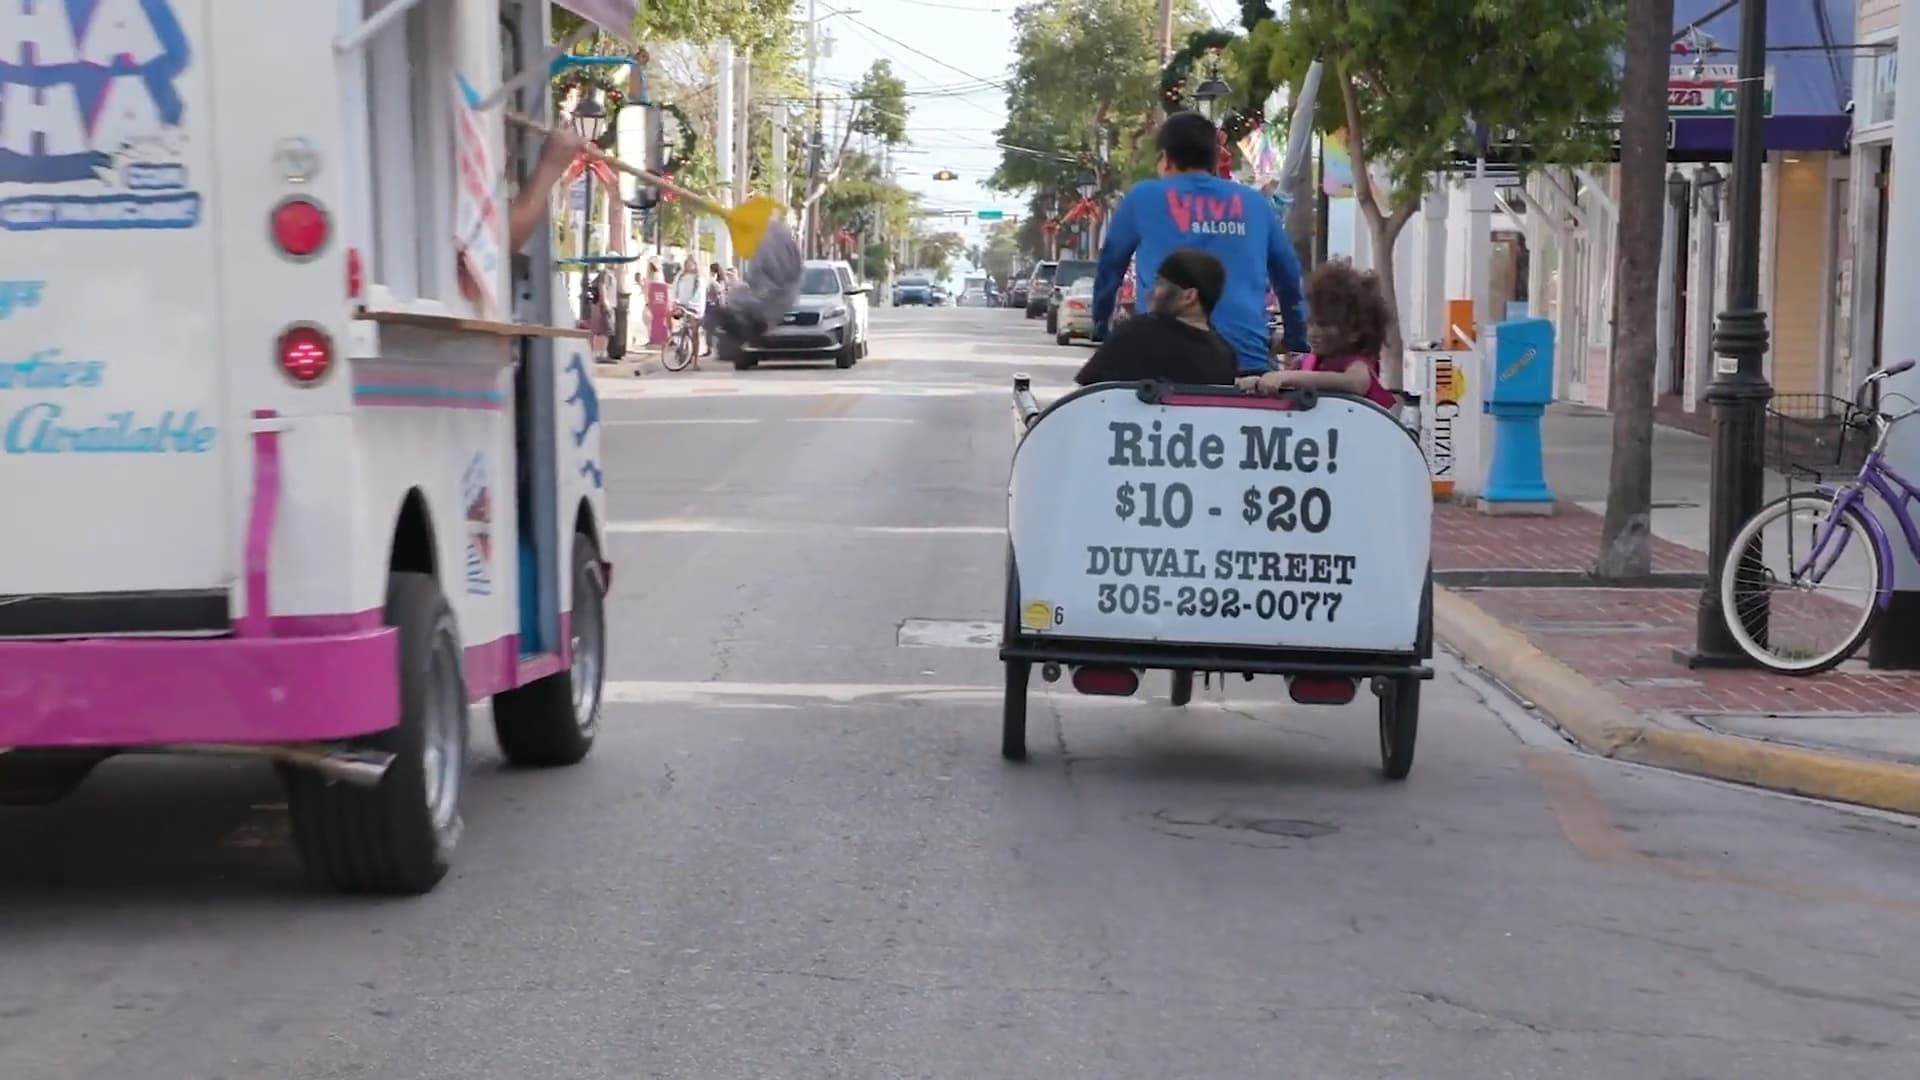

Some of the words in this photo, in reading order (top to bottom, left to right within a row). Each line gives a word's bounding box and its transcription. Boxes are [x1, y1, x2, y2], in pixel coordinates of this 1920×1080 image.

[1165, 187, 1244, 233] VIVA
[1191, 221, 1246, 236] SALOON
[1108, 420, 1225, 470] Ride
[1239, 425, 1339, 474] Me!
[1115, 481, 1194, 529] $10
[1242, 485, 1332, 534] $20
[1086, 545, 1206, 579] DUVAL
[1214, 550, 1356, 585] STREET
[1054, 606, 1065, 625] 6
[1098, 583, 1343, 623] 305-292-0077
